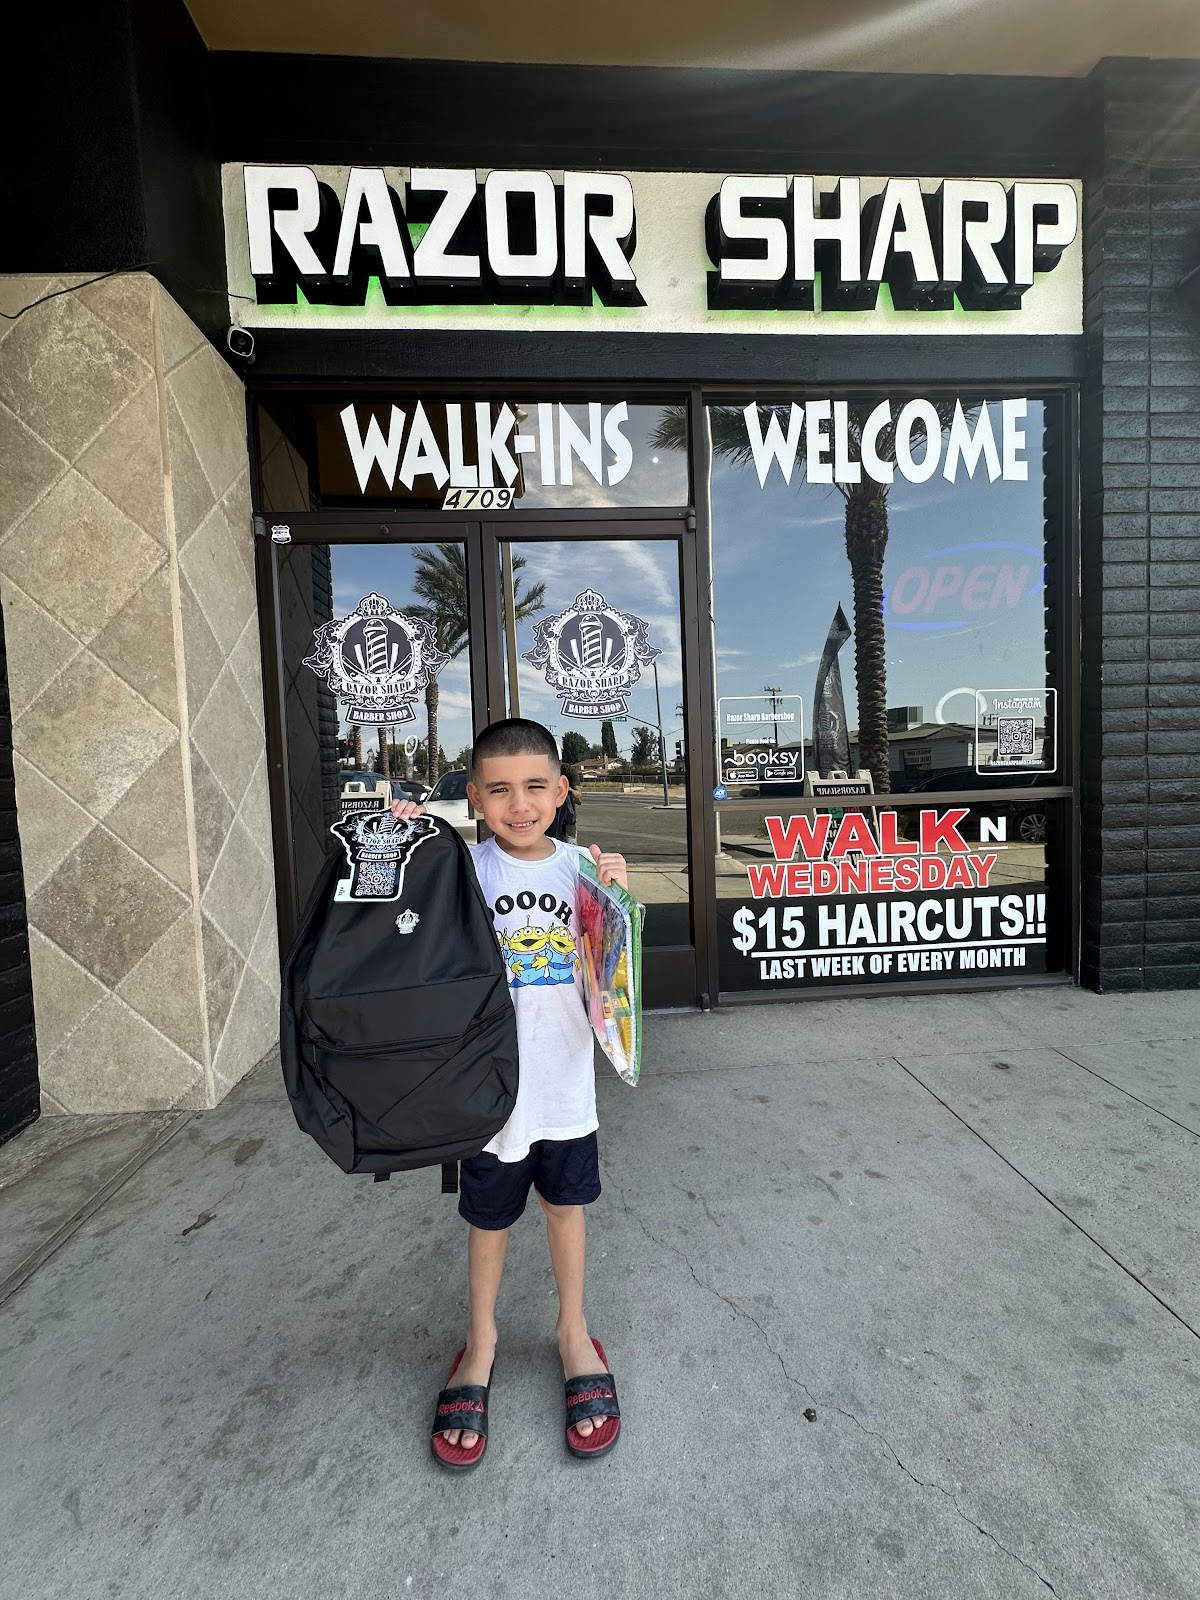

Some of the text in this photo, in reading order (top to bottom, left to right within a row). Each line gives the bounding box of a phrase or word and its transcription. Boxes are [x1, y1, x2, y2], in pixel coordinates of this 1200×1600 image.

[243, 165, 1077, 284] RAZOR SHARP
[340, 398, 1029, 494] WALK-INS WELCOME
[445, 489, 511, 509] 4709
[891, 564, 1032, 615] OPEN
[346, 681, 411, 695] RAZOR SHARP
[562, 675, 625, 689] RAZOR SHARP
[568, 702, 622, 715] BARBER SHOP
[992, 698, 1043, 713] Instagram
[352, 709, 409, 722] BARBER SHOP
[726, 712, 795, 722] Razor Sharp Barbershop
[724, 749, 799, 766] booksy
[765, 809, 971, 861] WALK
[979, 816, 1007, 843] N
[382, 851, 398, 859] SHOP
[747, 854, 998, 899] WEDNESDAY
[732, 893, 1047, 956] $15 HAIRCUTS!!
[760, 946, 1026, 980] LAST WEEK OF EVERY MONTH
[567, 1388, 603, 1408] Reebok
[438, 1400, 475, 1416] Reebok
